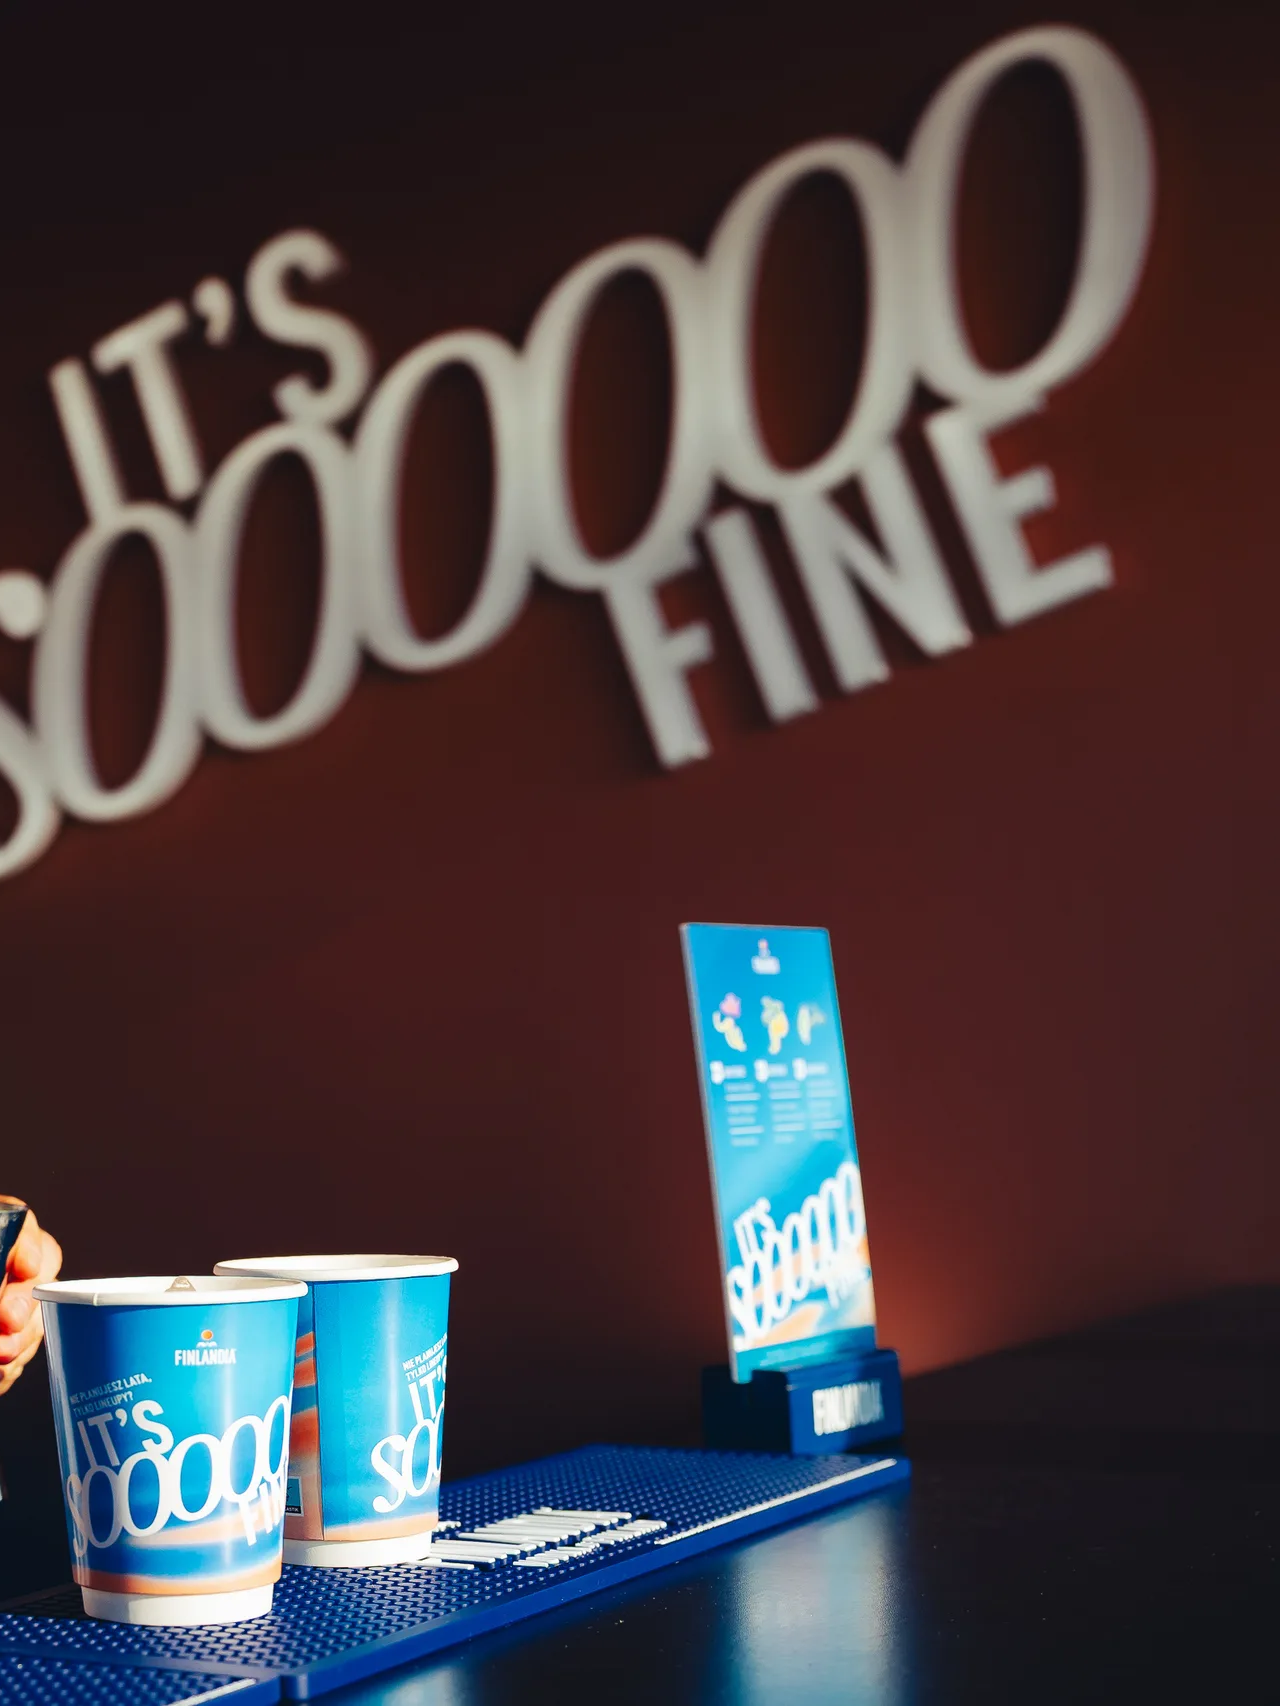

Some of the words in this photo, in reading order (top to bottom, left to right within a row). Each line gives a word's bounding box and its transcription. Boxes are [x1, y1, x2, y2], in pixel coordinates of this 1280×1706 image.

[602, 398, 1113, 770] FINE
[79, 1379, 124, 1401] PLANUJESZ
[123, 1373, 152, 1389] LATA,
[174, 1348, 237, 1367] FINLANDIA
[73, 1402, 95, 1418] TYLKO
[93, 1390, 134, 1411] LINEUPY?
[76, 1399, 175, 1470] IT'S
[66, 1388, 294, 1558] SOOOOO
[237, 1468, 287, 1547] FIN
